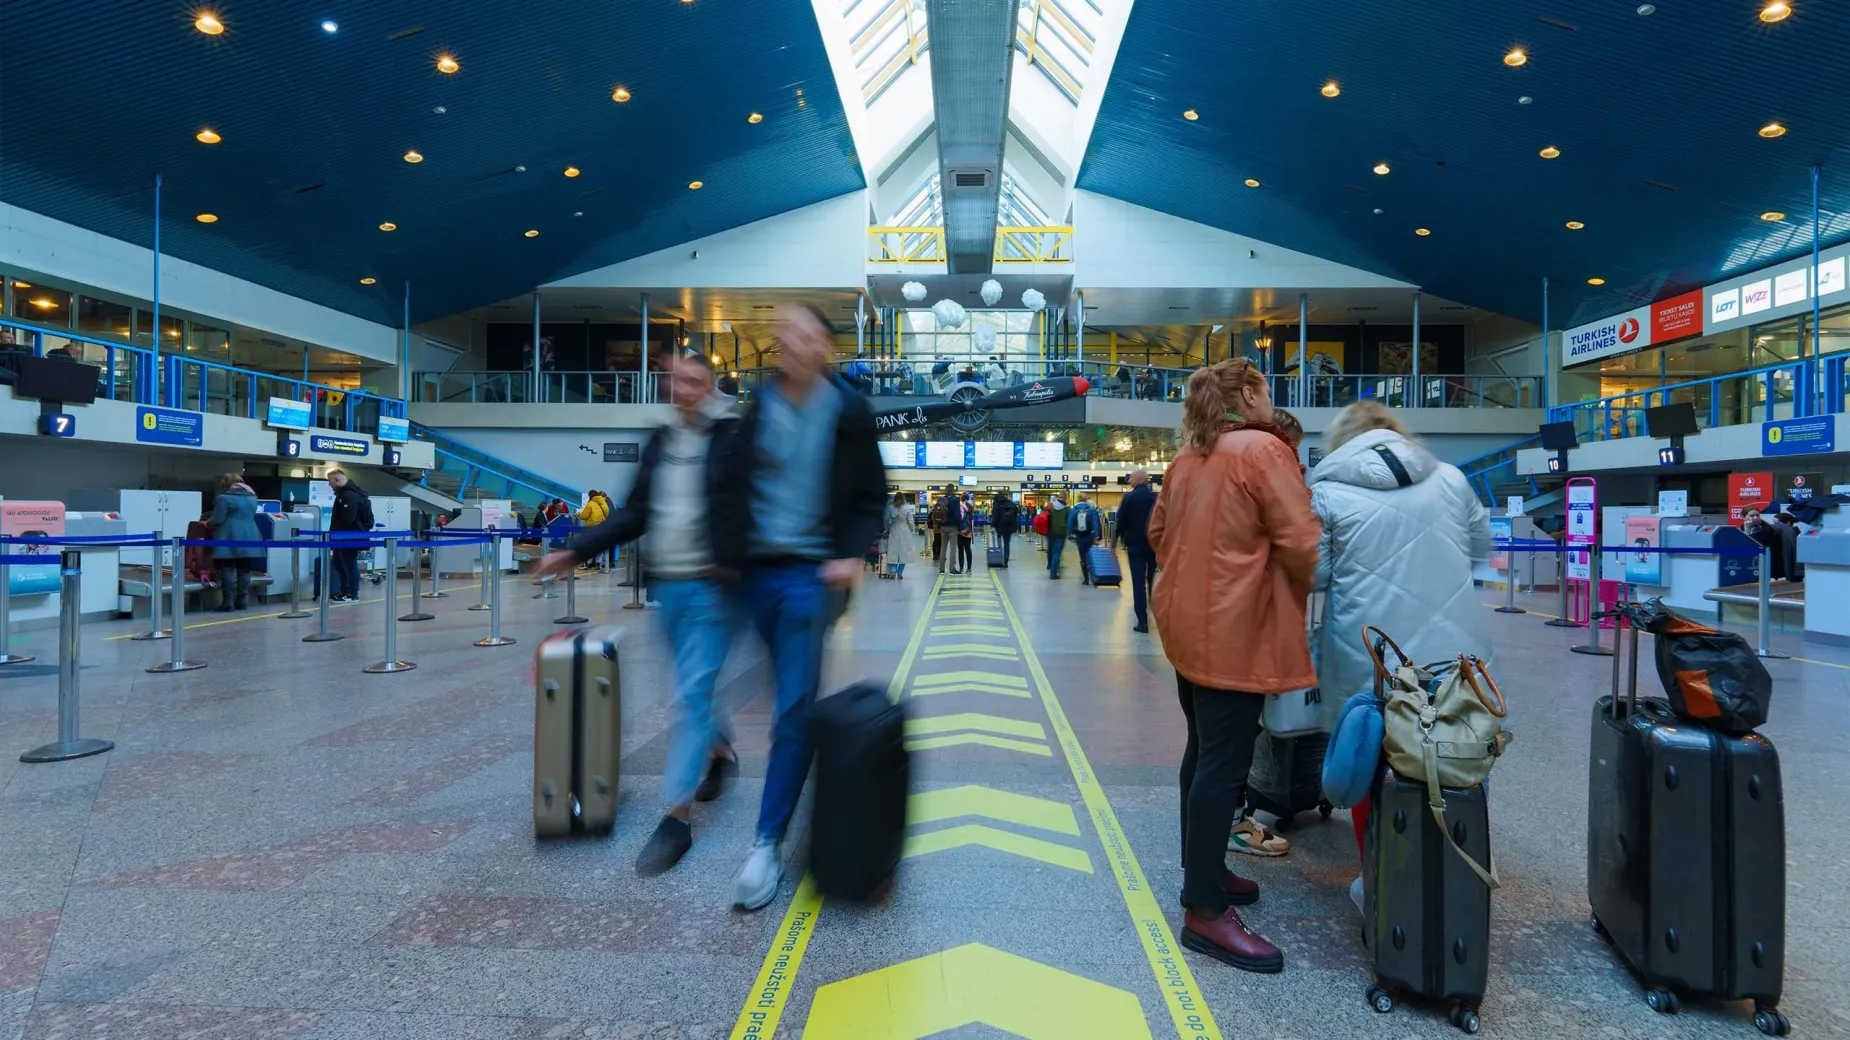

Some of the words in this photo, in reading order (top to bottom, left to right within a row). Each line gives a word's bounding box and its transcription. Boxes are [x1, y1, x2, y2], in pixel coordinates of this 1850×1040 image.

[1660, 306, 1678, 316] TICKET
[1679, 302, 1695, 311] SALES
[1715, 300, 1736, 313] LOT
[1571, 325, 1616, 345] TURKISH
[1571, 336, 1616, 357] AIRLINES
[57, 417, 69, 433] 7
[289, 443, 297, 455] 8
[1661, 451, 1674, 463] 11
[393, 453, 399, 464] 9
[1549, 460, 1559, 470] 10
[782, 911, 812, 952] Prašome
[1142, 919, 1170, 955] access!
[1158, 958, 1185, 986] block
[757, 954, 790, 1008] neužstoti
[1173, 990, 1196, 1011] not
[1184, 1015, 1205, 1031] do
